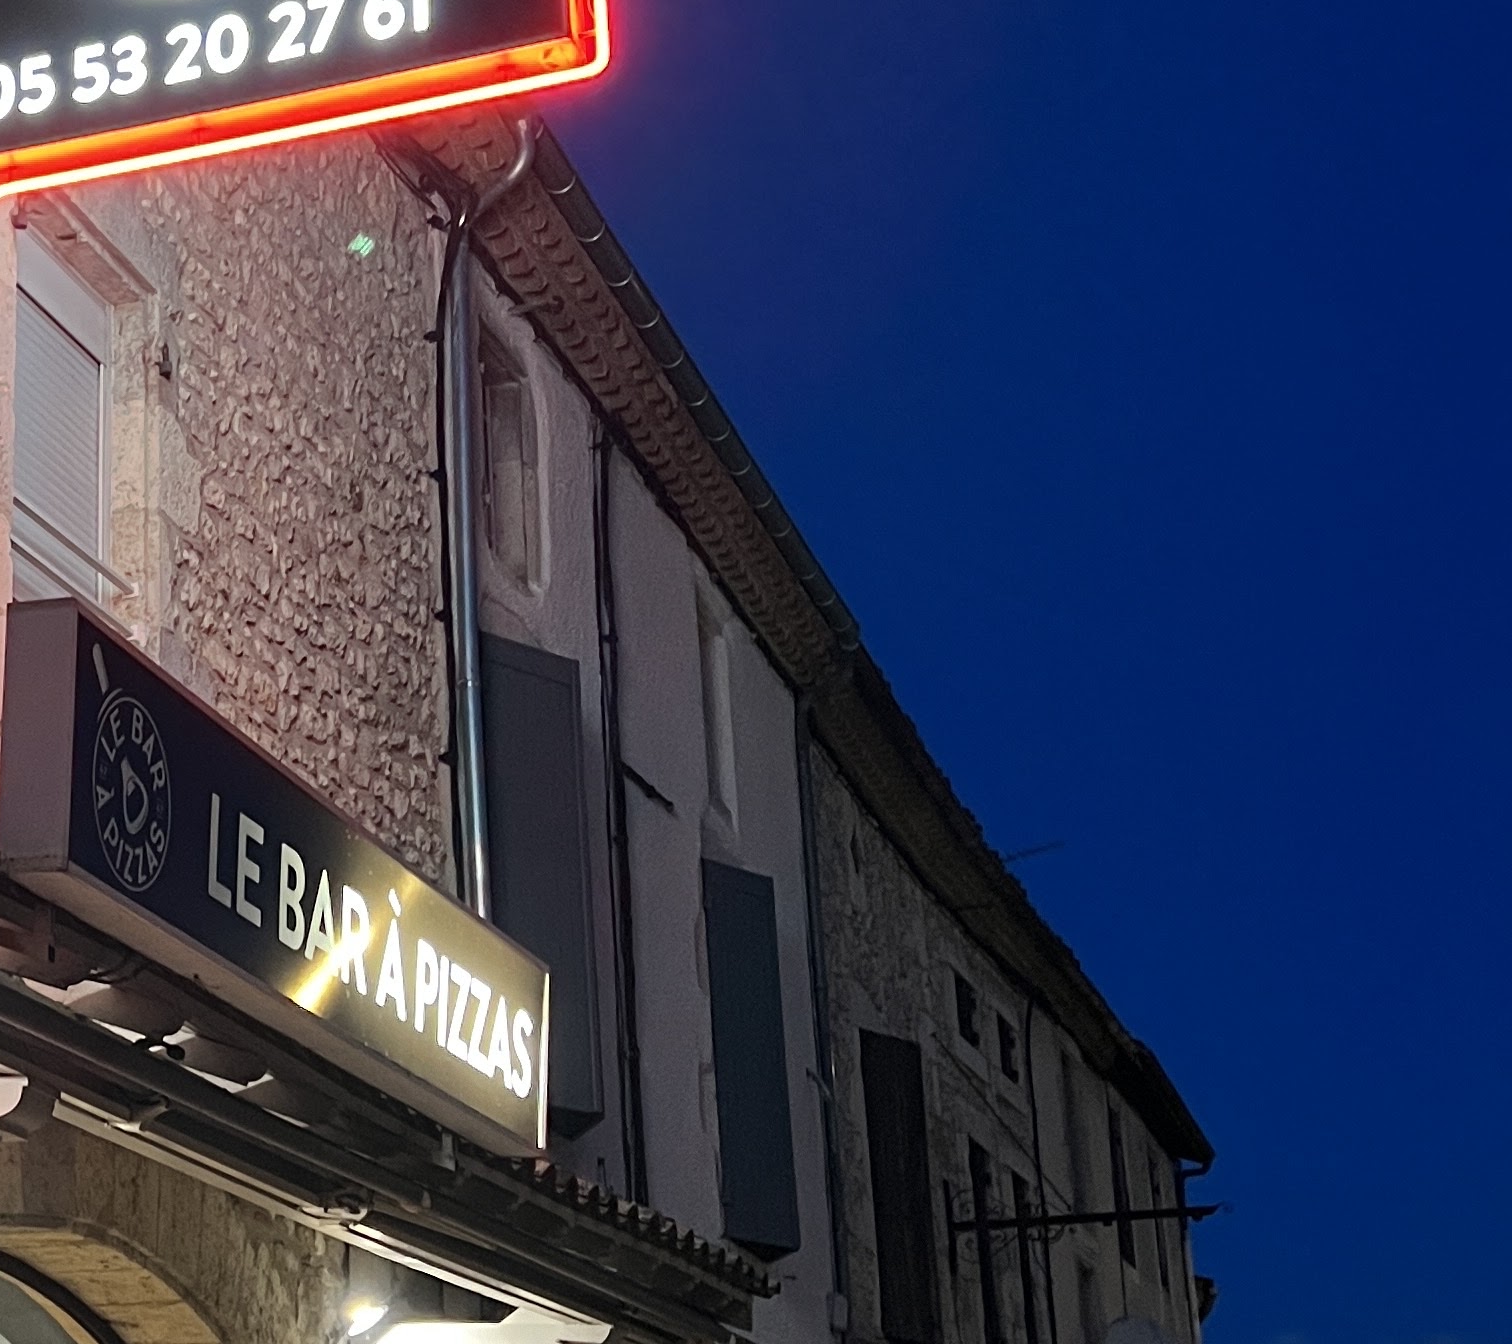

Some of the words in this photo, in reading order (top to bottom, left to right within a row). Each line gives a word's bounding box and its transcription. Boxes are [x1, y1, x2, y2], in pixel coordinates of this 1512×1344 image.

[71, 35, 148, 103] 53
[164, 13, 249, 85] 20
[100, 707, 126, 763] LE
[131, 707, 166, 792] BAR
[102, 816, 166, 885] PIZZAS
[207, 792, 265, 929] LE
[278, 842, 371, 997] BAR
[375, 888, 407, 1023] À
[414, 938, 534, 1099] PIZZAS
